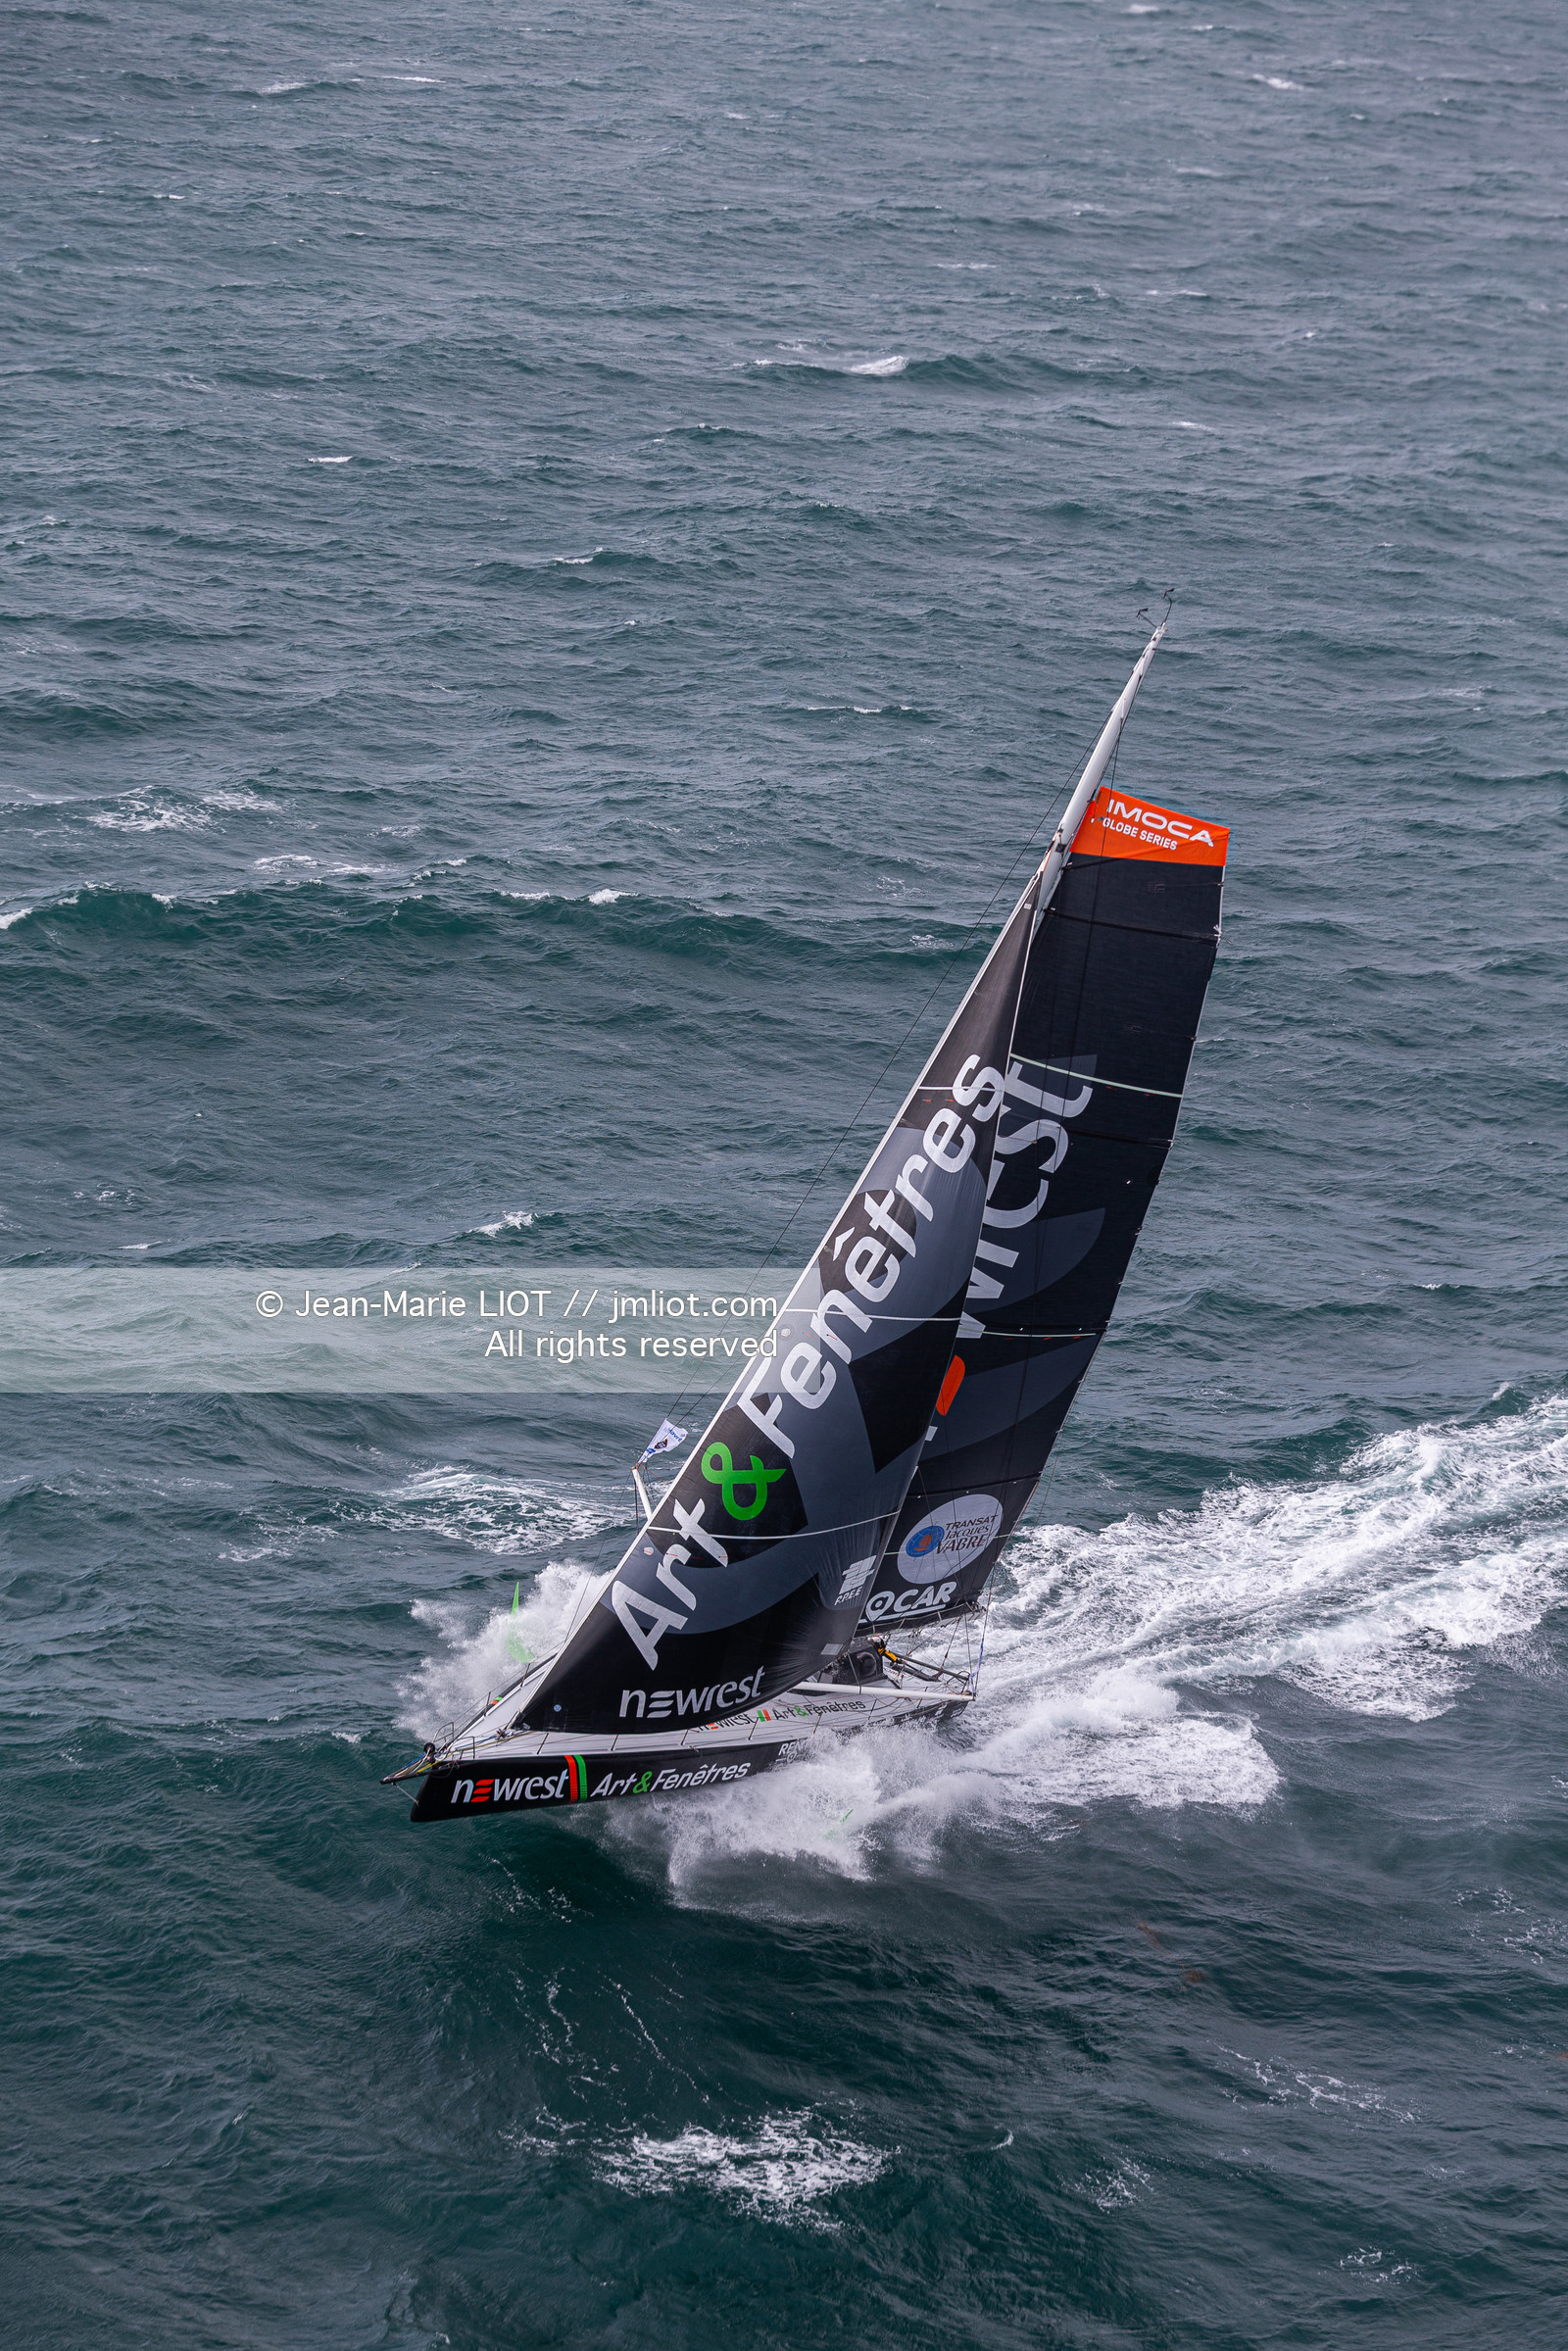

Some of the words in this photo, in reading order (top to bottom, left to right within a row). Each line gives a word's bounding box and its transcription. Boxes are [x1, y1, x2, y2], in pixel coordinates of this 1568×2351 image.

[1102, 816, 1140, 839] GLOBE
[1139, 830, 1178, 852] SERIES
[1106, 799, 1214, 848] IMOCA
[946, 1514, 999, 1531] TRANSAT
[936, 1533, 989, 1554] VABRE
[618, 1665, 765, 1719] newrest
[450, 1768, 569, 1804] newrest
